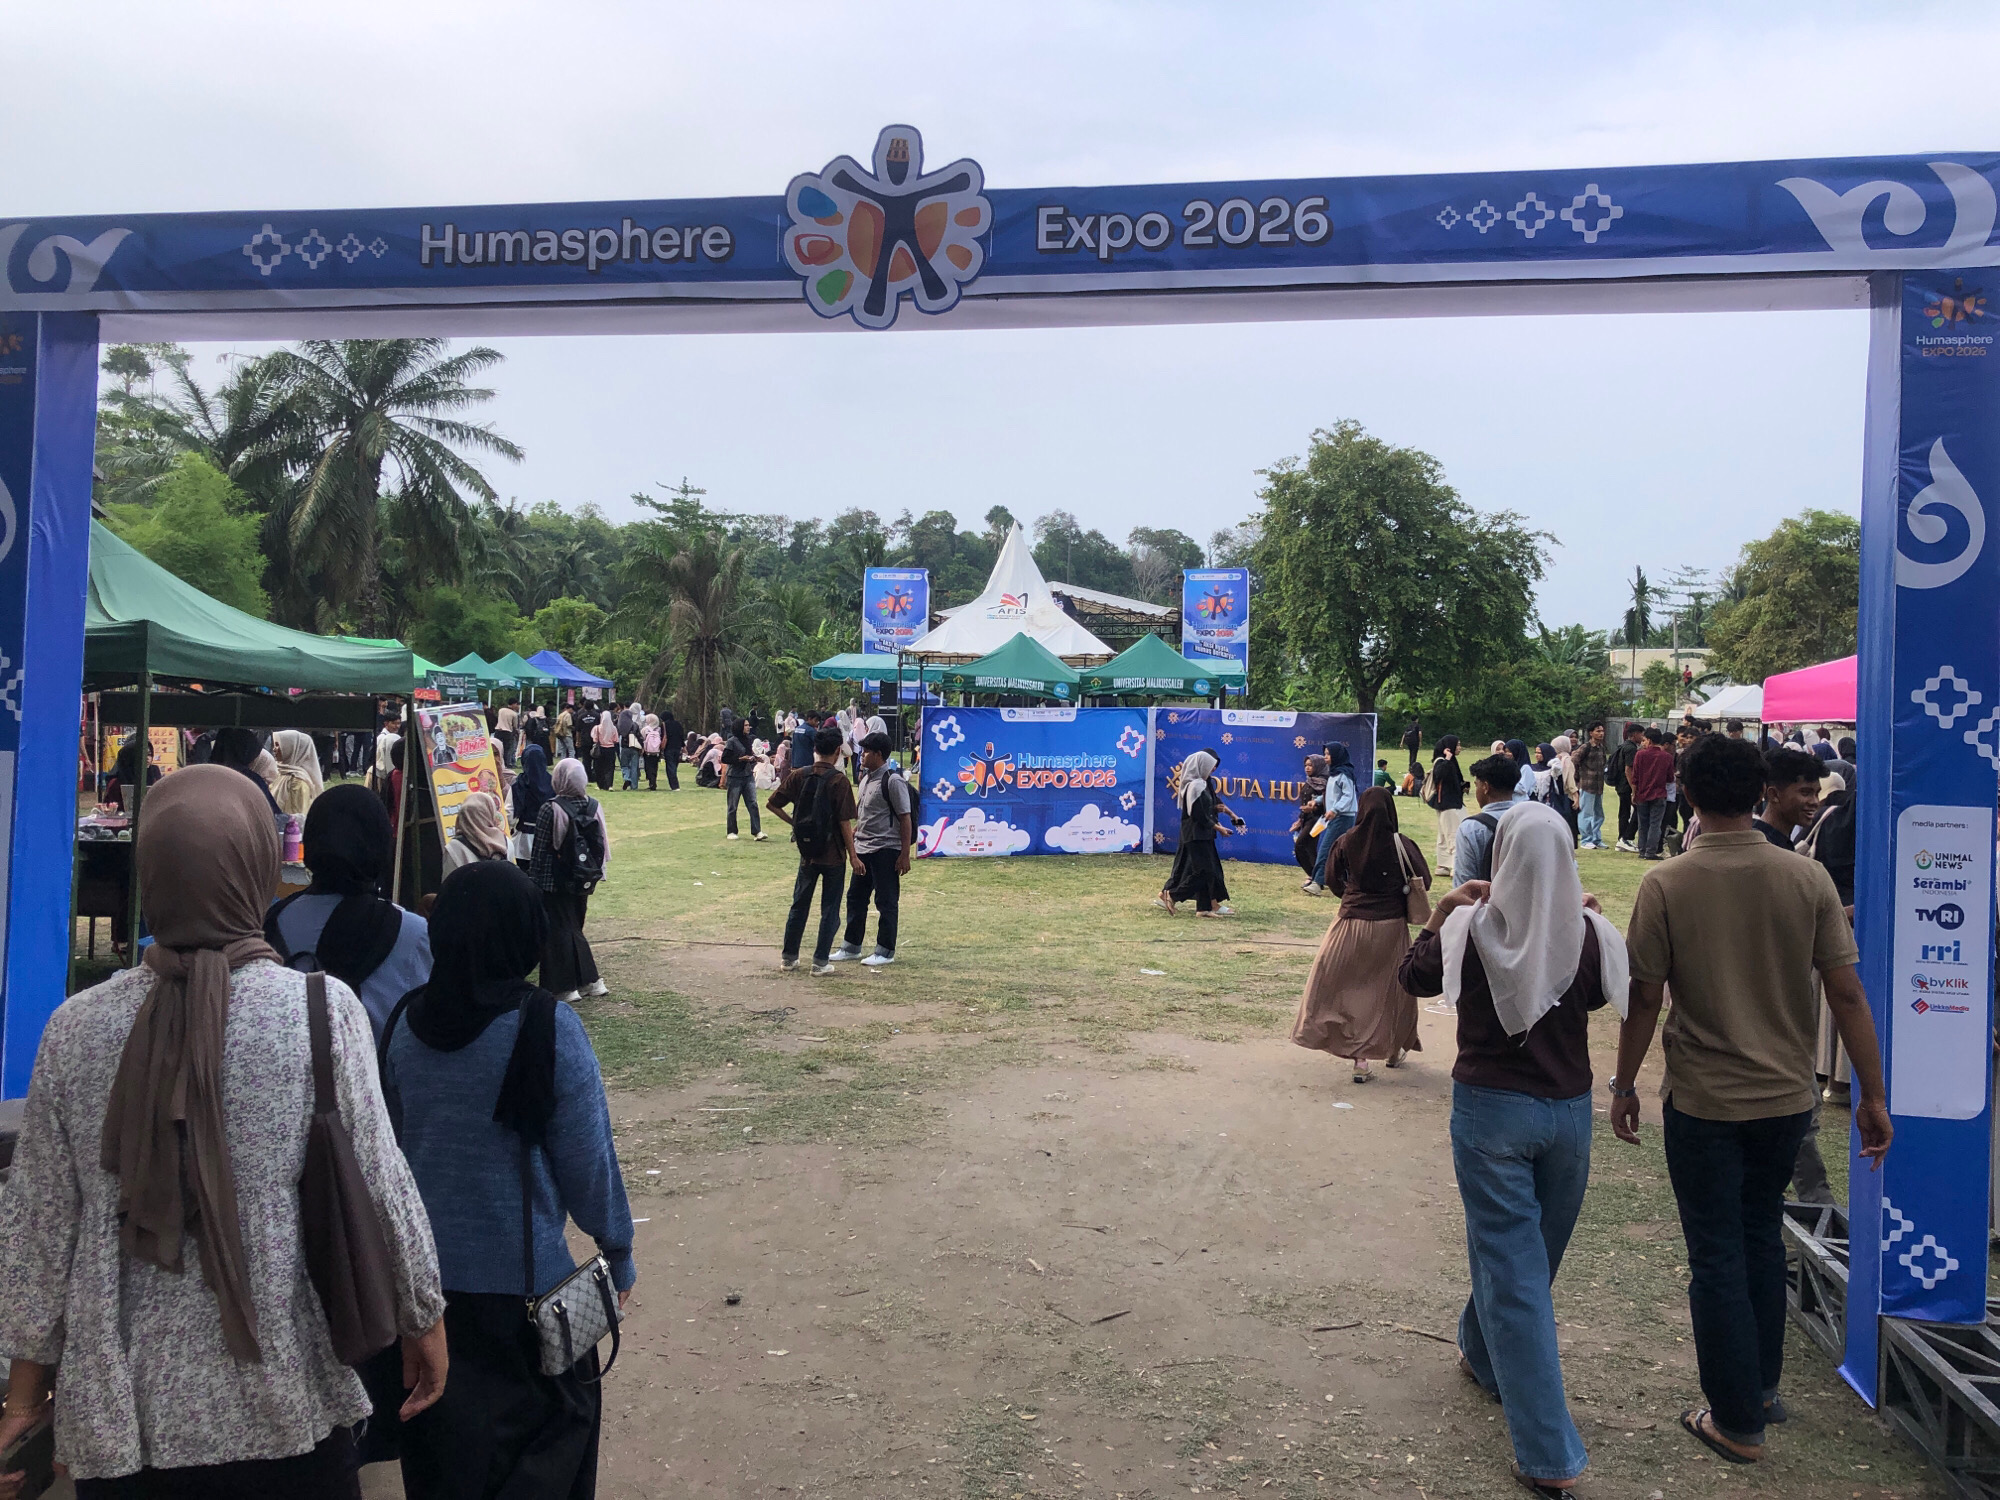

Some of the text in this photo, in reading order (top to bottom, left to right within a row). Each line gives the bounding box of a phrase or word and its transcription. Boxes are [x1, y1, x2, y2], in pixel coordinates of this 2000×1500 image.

[420, 196, 1330, 272] Humasphere Expo 2026
[1915, 334, 1994, 347] Humasphere
[1922, 346, 1987, 357] EXPO 2026
[876, 628, 894, 636] EXPO
[1196, 629, 1216, 637] EXPO
[975, 676, 1007, 688] UNIVERSITAS
[1113, 677, 1184, 690] UNIVERSITAS MALIKUSSALEH
[1017, 752, 1117, 770] Humasphere
[1016, 769, 1117, 788] EXPO 2026
[1912, 820, 1934, 828] media
[1935, 852, 1973, 862] UNIMAL
[1935, 861, 1963, 870] NEWS
[1913, 877, 1967, 891] Serambi
[1915, 907, 1960, 924] TVRI
[1922, 940, 1961, 961] rri
